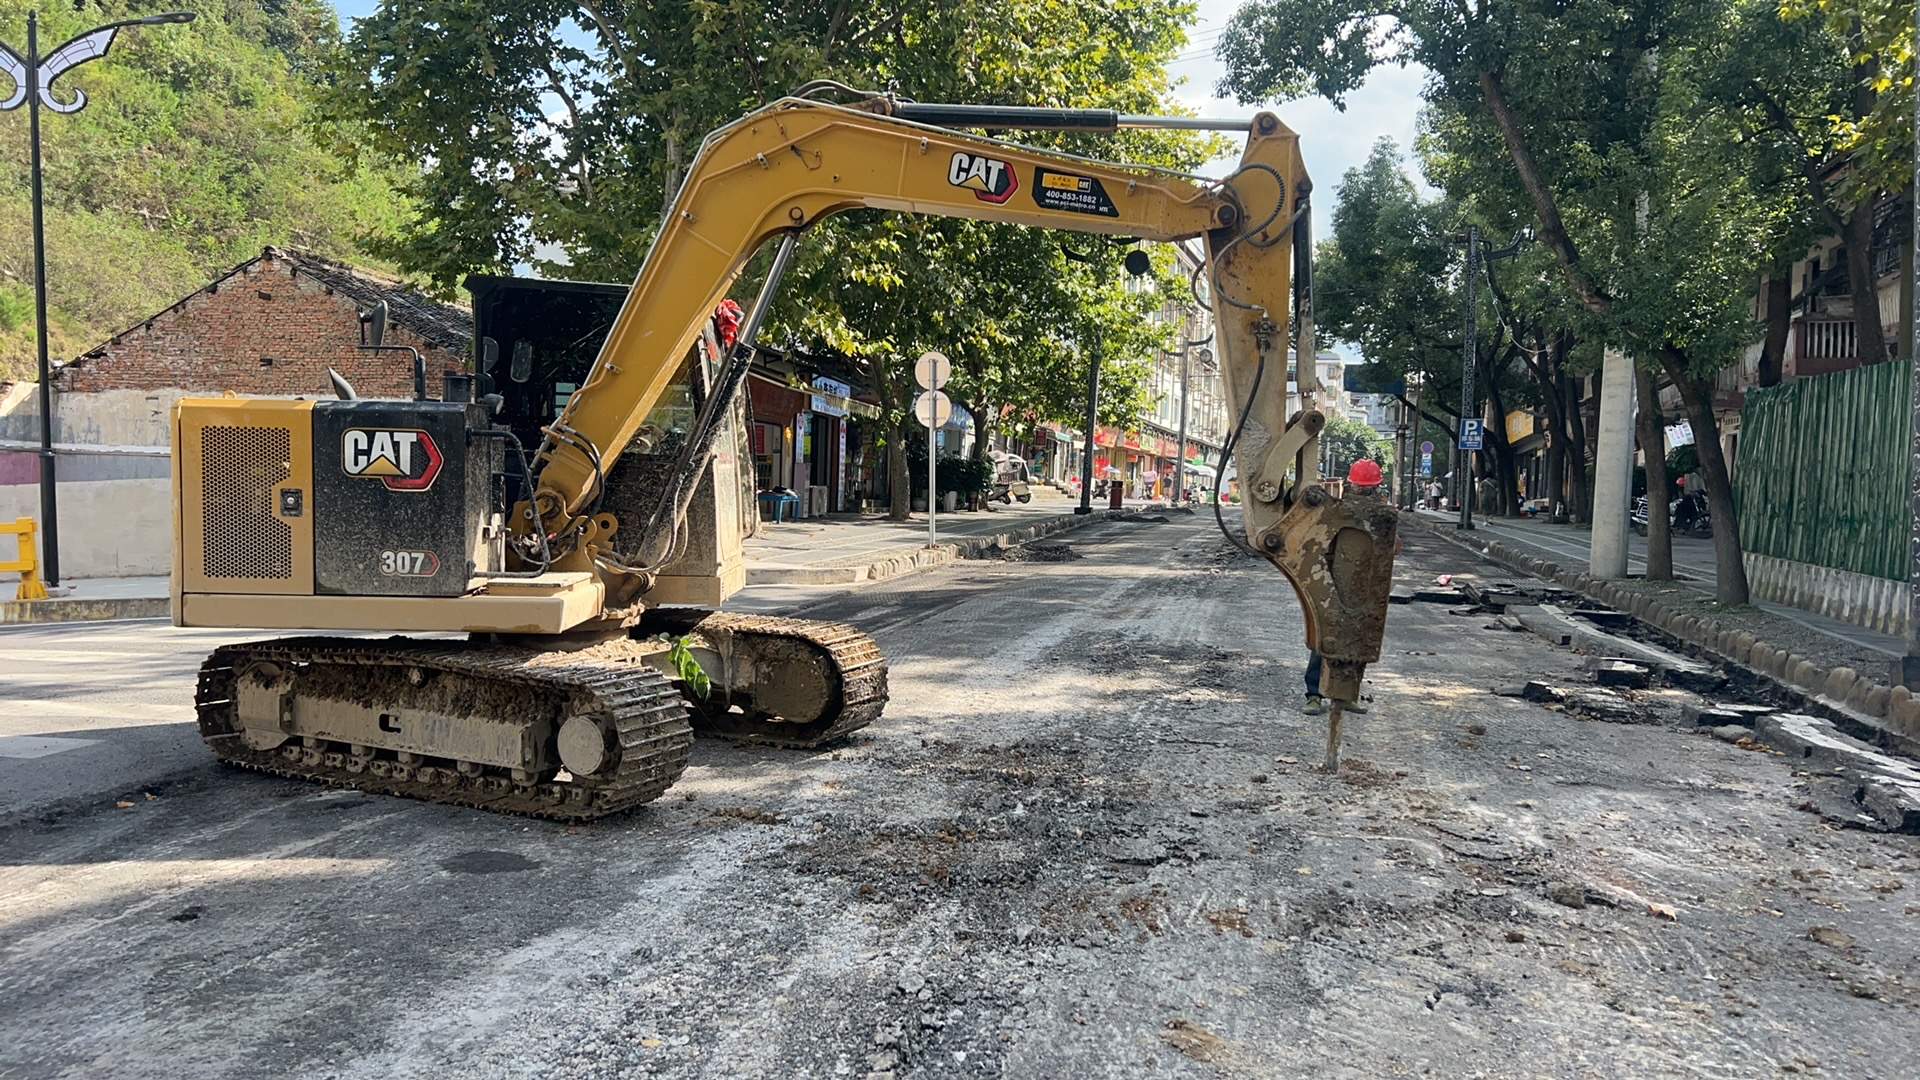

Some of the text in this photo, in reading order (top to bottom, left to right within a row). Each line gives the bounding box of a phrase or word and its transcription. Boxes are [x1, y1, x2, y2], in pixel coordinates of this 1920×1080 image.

[951, 153, 1004, 193] CAT
[1045, 190, 1097, 204] 400-853-1882
[1464, 421, 1477, 435] P
[344, 430, 417, 475] CAT
[381, 551, 425, 574] 307
